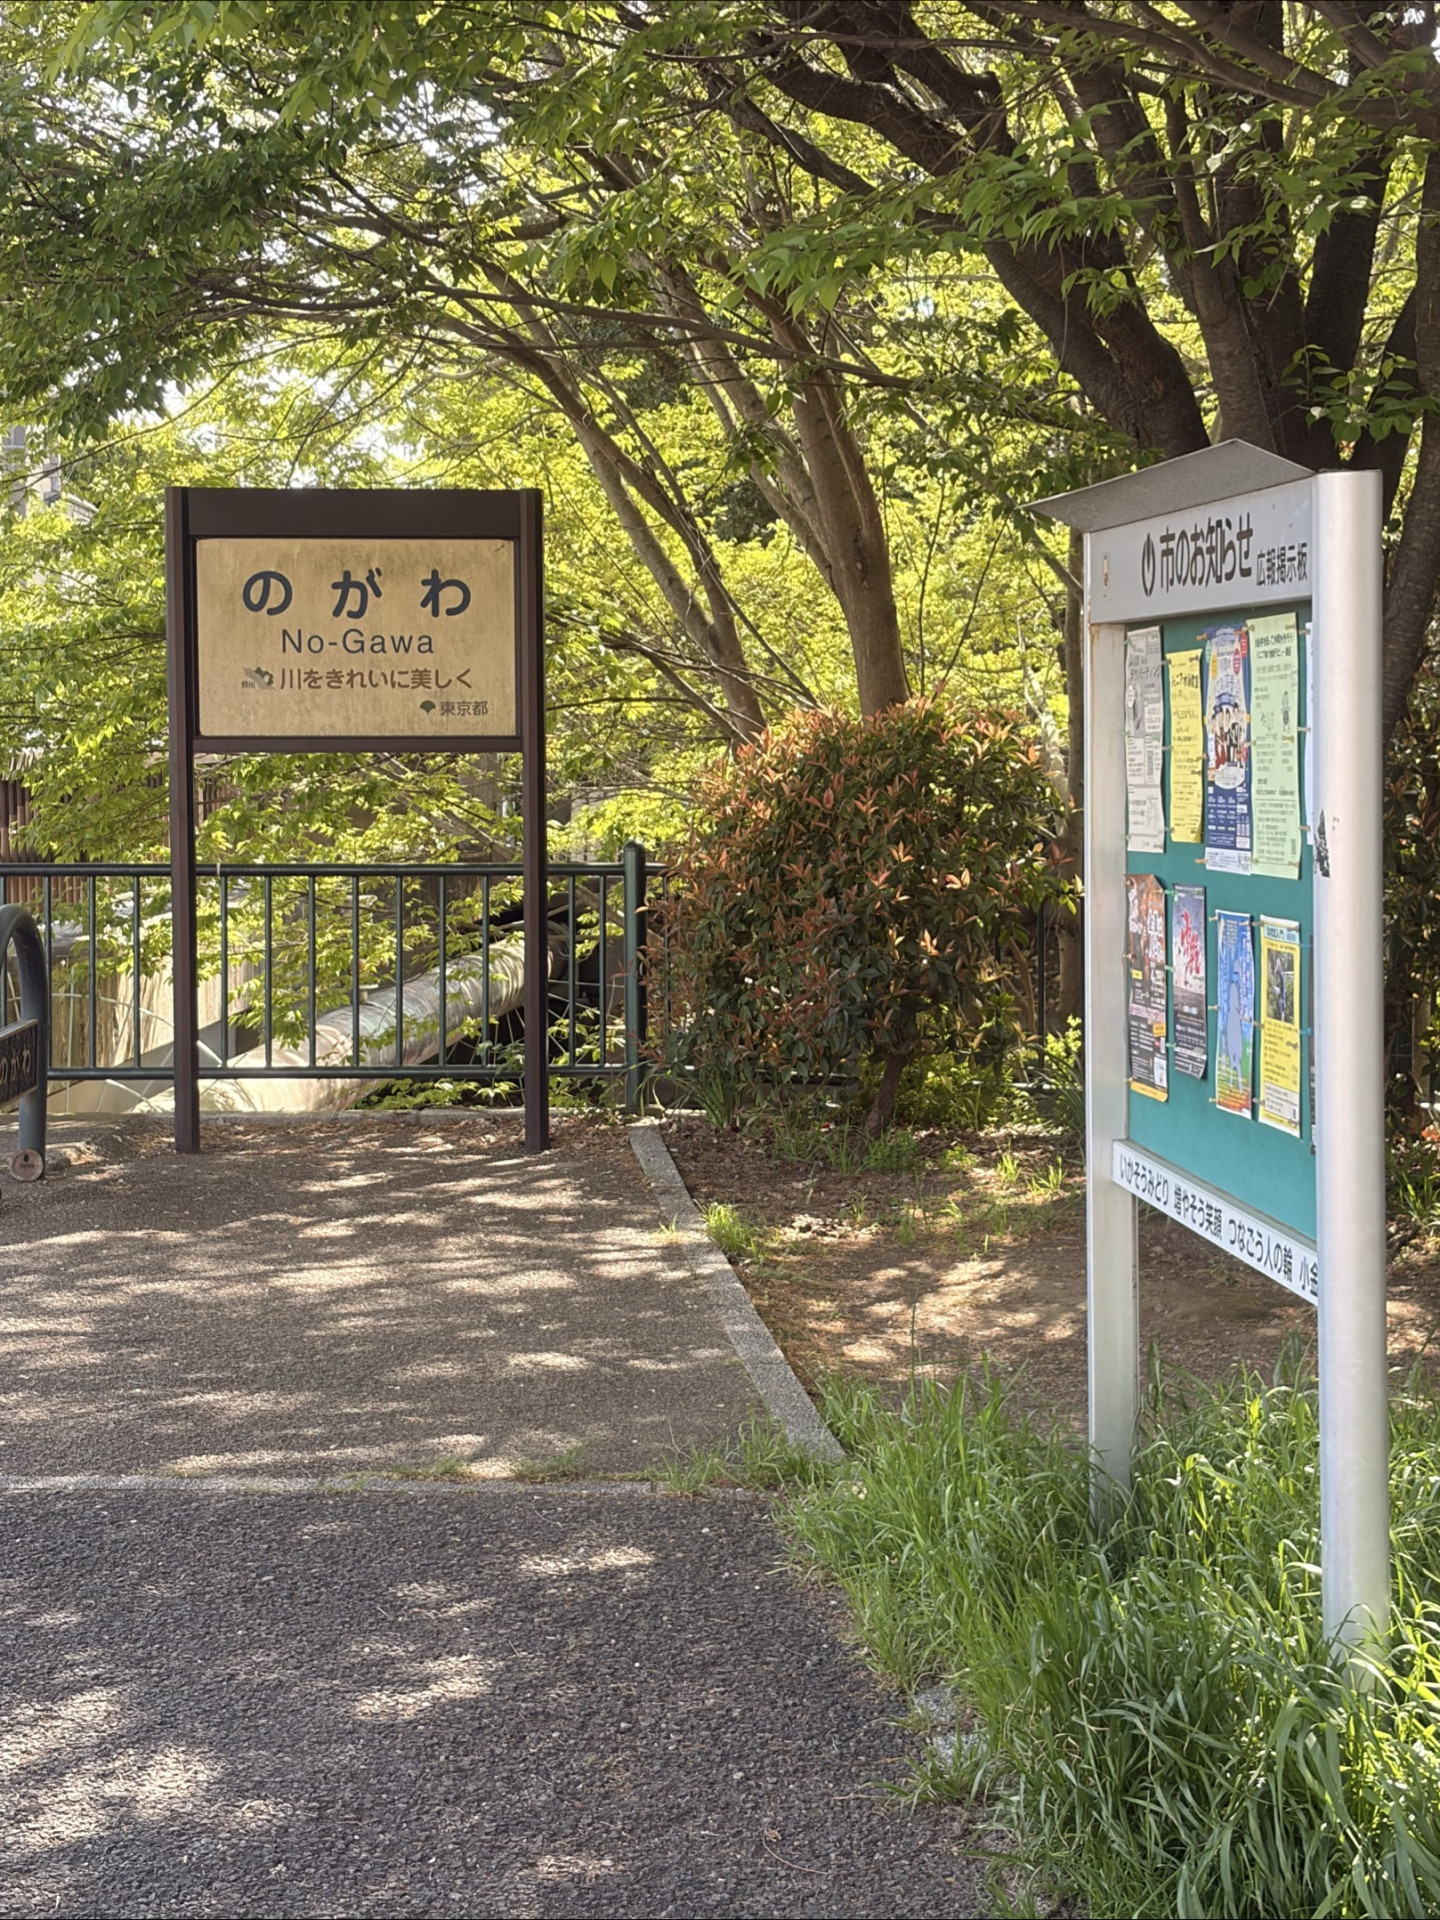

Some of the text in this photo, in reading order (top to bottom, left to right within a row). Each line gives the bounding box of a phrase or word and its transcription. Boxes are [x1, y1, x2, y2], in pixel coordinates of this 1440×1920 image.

[1159, 512, 1308, 594] 市のお知らせ 広報掲示板
[242, 567, 472, 619] のがわ
[281, 628, 435, 655] No-Gawa
[279, 667, 473, 690] 川をきれいに美しく
[439, 700, 489, 717] 東京都
[1173, 1183, 1223, 1241] 増やそう笑顔
[1228, 1217, 1294, 1283] つなごう人の輪
